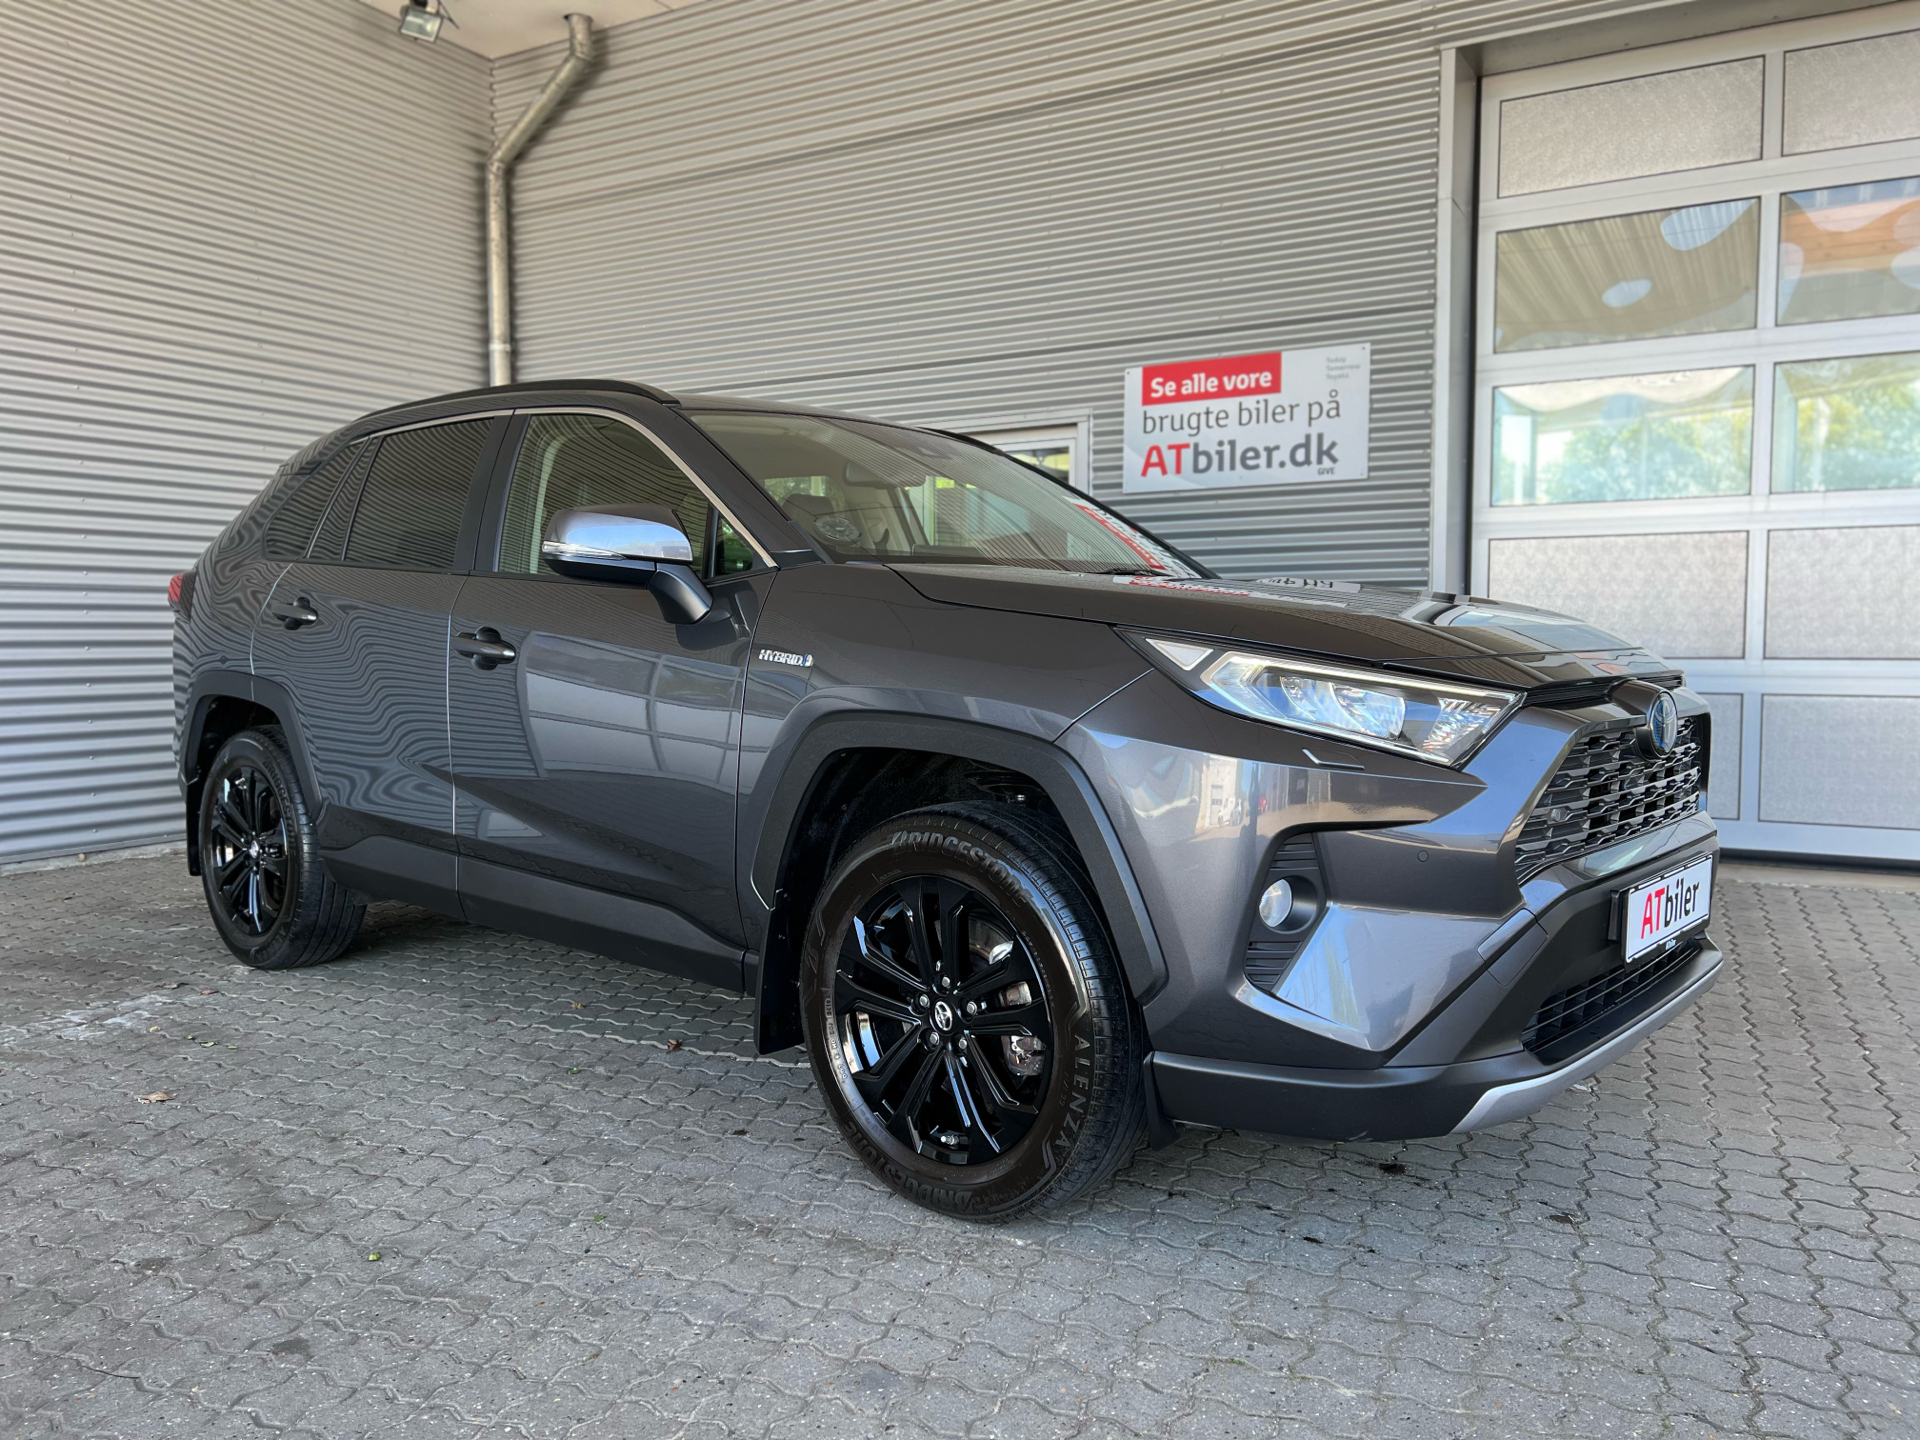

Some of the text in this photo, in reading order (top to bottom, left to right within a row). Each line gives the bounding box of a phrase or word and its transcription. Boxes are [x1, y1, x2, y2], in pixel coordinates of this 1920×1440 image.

[1150, 371, 1272, 398] Se alle vore
[1143, 389, 1341, 437] brugte biler på
[1140, 432, 1340, 478] ATbiler.dk
[1317, 466, 1335, 476] GIVE
[758, 649, 803, 666] HYBRID
[891, 830, 1034, 907] BRIDGESTONE
[1640, 878, 1700, 939] ATbiler
[1055, 1034, 1091, 1148] ALENZA
